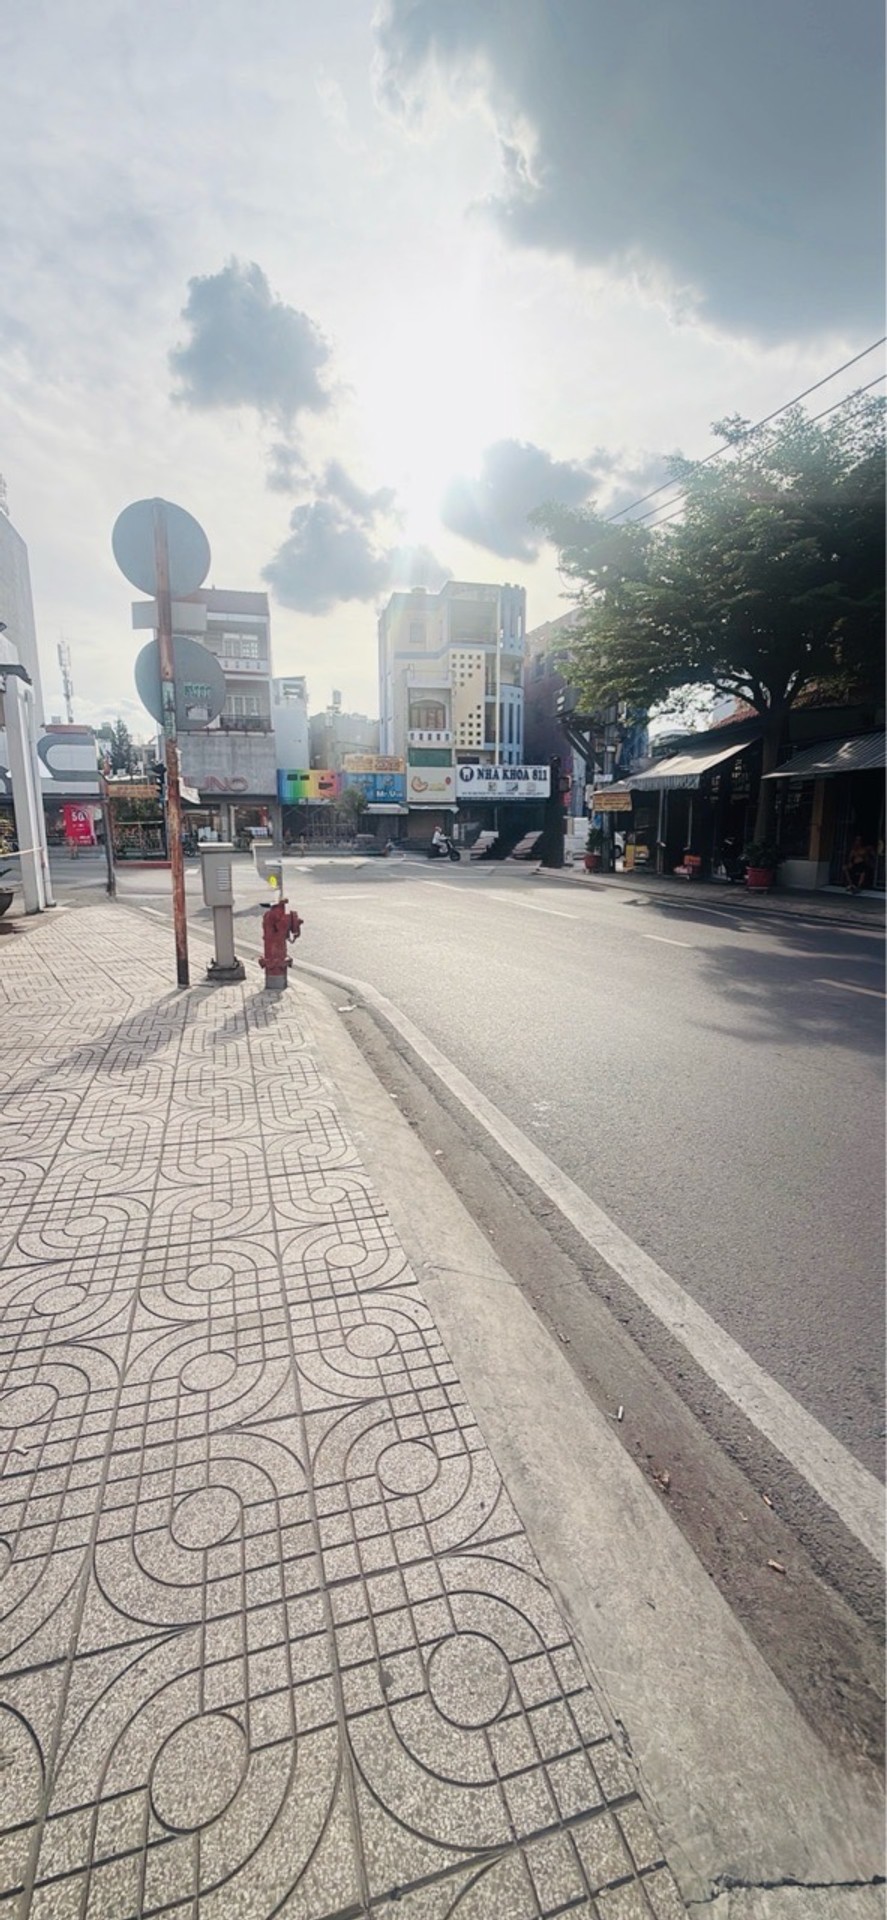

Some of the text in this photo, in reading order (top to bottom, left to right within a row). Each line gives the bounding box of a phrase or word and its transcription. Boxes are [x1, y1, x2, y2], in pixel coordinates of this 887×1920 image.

[477, 768, 548, 781] NHA KHOA 811
